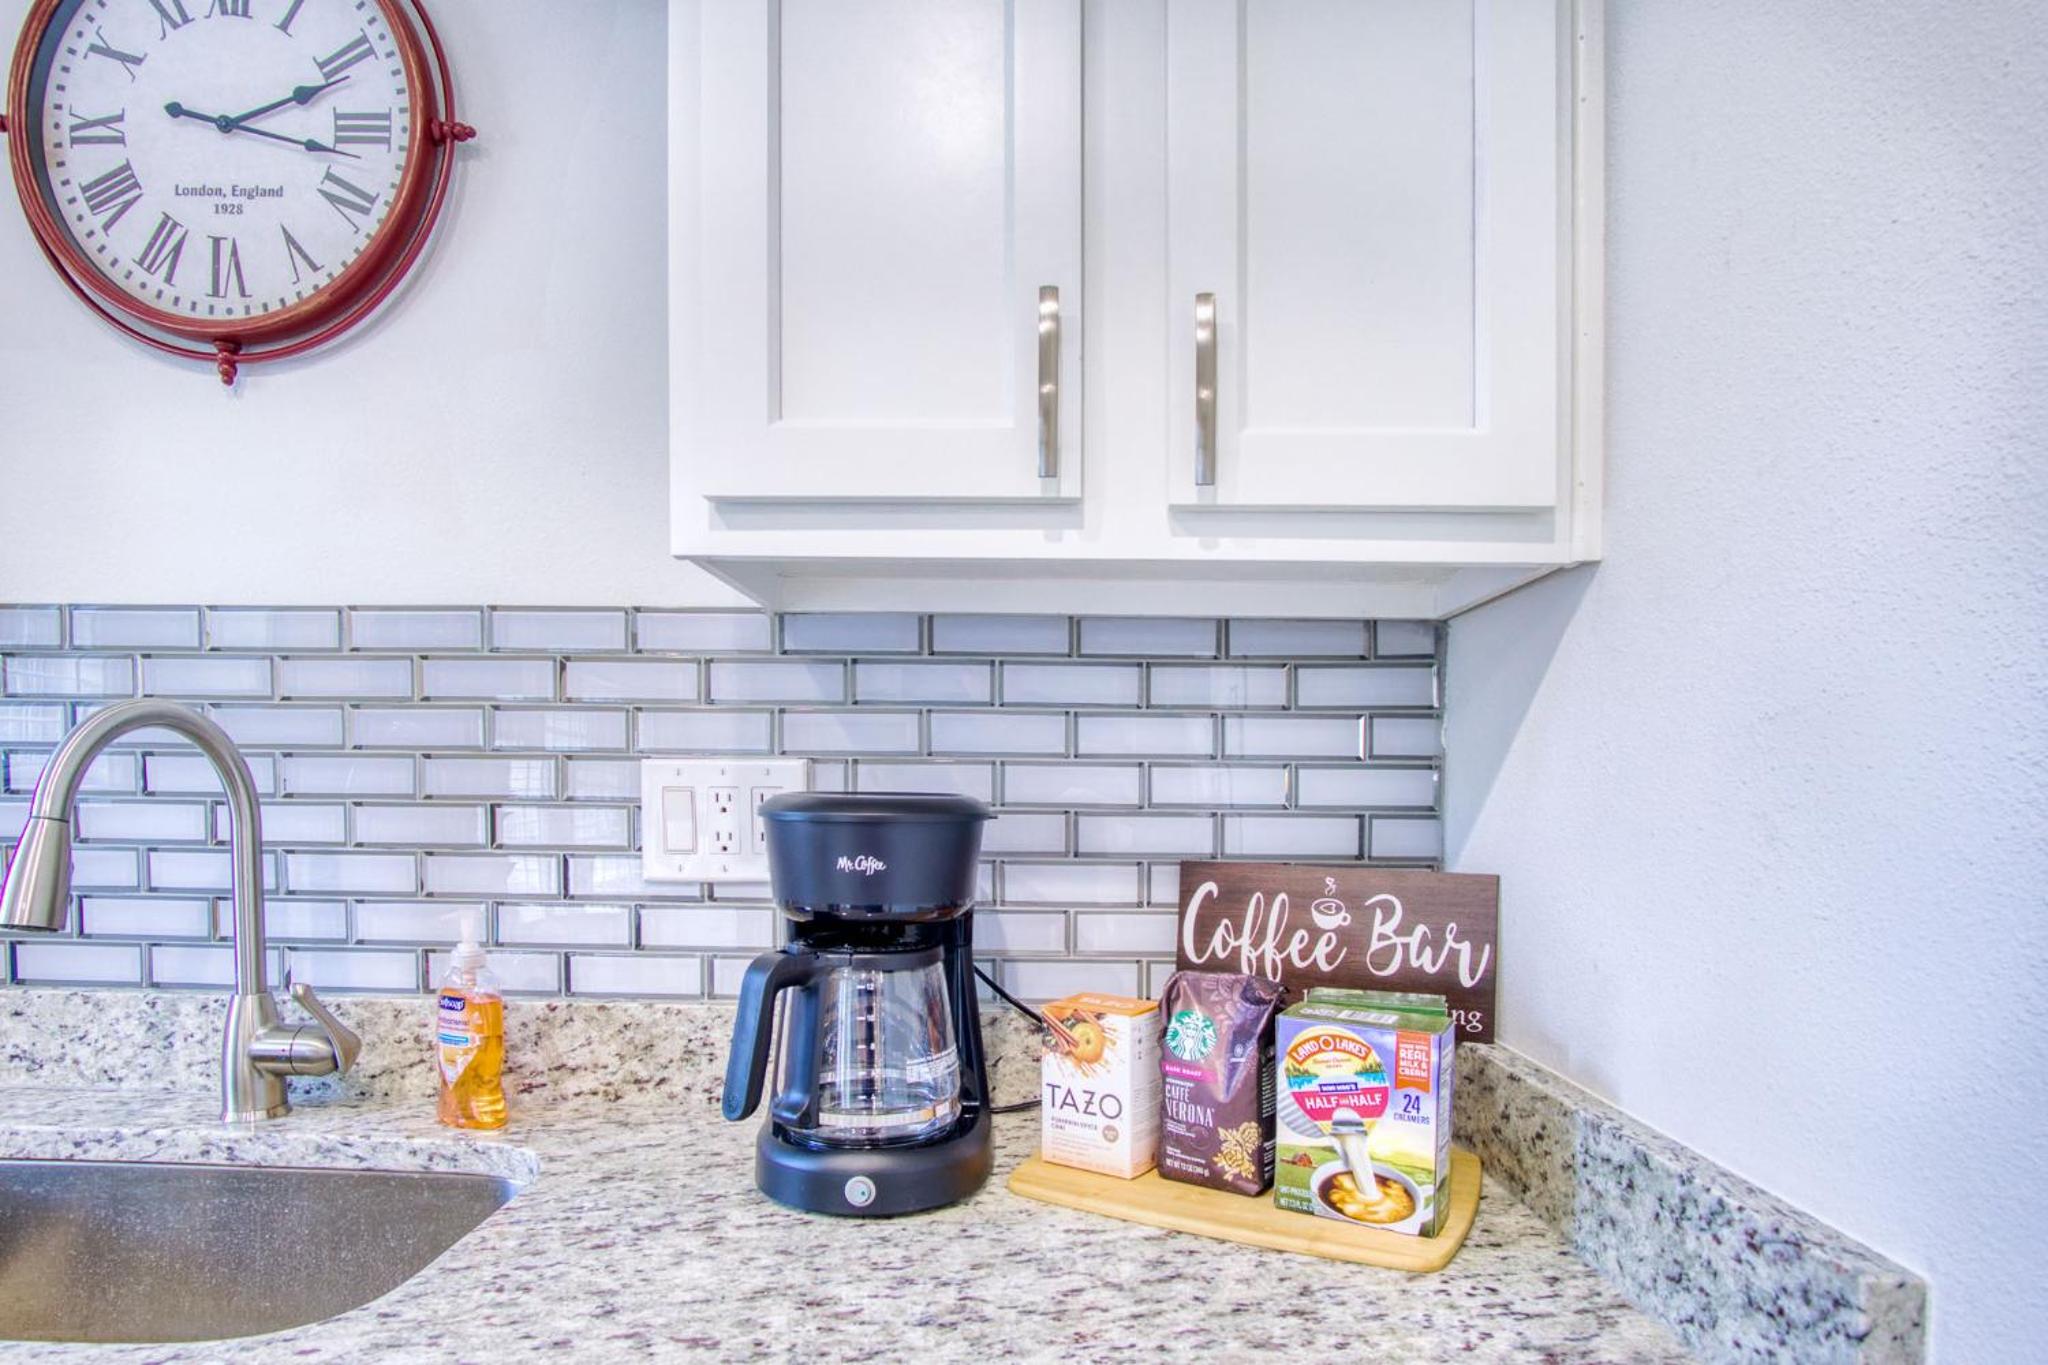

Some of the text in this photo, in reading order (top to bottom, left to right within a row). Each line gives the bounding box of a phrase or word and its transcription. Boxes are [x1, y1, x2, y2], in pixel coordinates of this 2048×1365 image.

[83, 25, 148, 83] X
[69, 104, 126, 149] IX
[332, 106, 392, 153] III
[174, 183, 284, 199] London, England
[213, 203, 244, 216] 1928
[205, 235, 253, 299] VI
[1183, 880, 1491, 988] Coffee Bar
[1291, 1040, 1319, 1060] LAND
[1336, 1038, 1367, 1058] LAKES
[1305, 1095, 1338, 1109] HALF
[1349, 1093, 1382, 1107] HALF
[1402, 1093, 1421, 1115] 24
